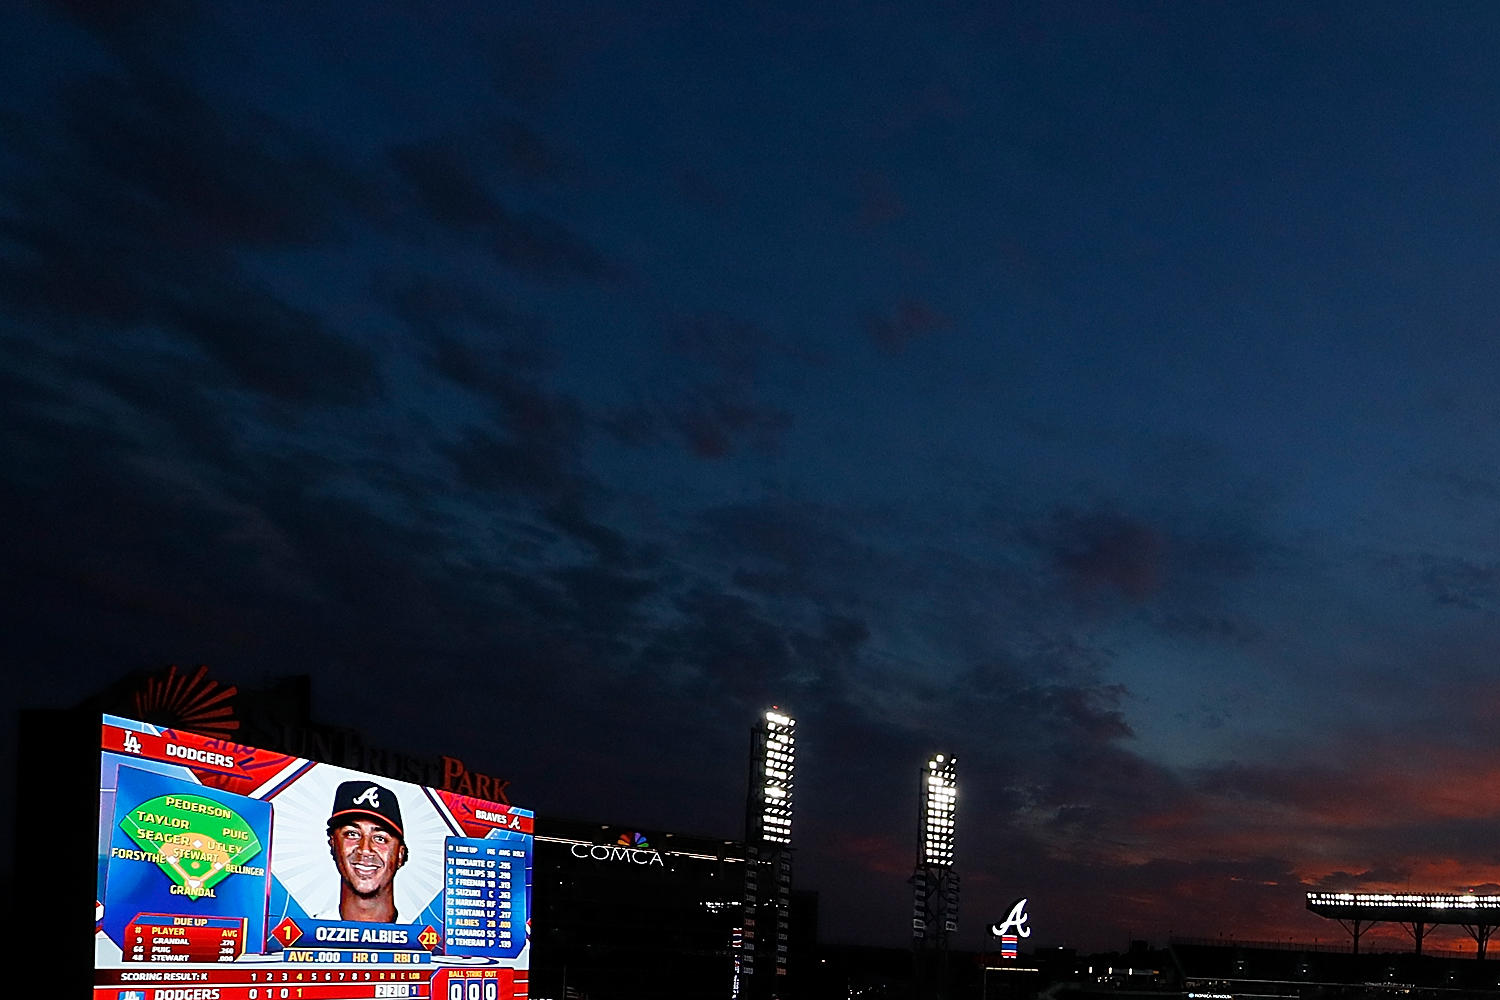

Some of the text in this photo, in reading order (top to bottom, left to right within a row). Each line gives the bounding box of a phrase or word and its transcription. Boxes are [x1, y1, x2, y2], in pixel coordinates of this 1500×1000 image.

[166, 743, 234, 768] DODGERS
[441, 756, 511, 804] PARK
[166, 796, 231, 819] PEDERSON
[137, 810, 190, 829] TAYLOR
[475, 810, 507, 824] BRAVES
[137, 828, 190, 845] SEAGER
[222, 828, 249, 840] PUIG
[207, 841, 242, 854] UTLEY
[112, 848, 166, 864] FORSYTHE
[173, 848, 219, 862] STEWART
[225, 864, 265, 876] BELLINGER
[170, 884, 216, 897] GRANDAL
[455, 908, 486, 917] SANTANA
[486, 910, 496, 918] LF
[173, 917, 208, 927] DUE UP
[455, 918, 480, 927] ALBIES
[152, 926, 185, 936] PLAYER
[222, 930, 238, 938] AVG
[281, 925, 292, 940] 1
[316, 927, 408, 944] OZZIE ALBIES
[422, 931, 438, 945] 2B
[152, 937, 190, 945] GRANDAL
[152, 946, 171, 954] PUIG
[151, 954, 189, 962] STEWART
[288, 951, 420, 963] AVG .000 HR 0 RBI 0
[121, 973, 208, 981] SCORING RESULT: K
[251, 973, 257, 981] 1
[266, 973, 273, 981] 2
[281, 973, 288, 981] 3
[296, 973, 303, 981] 4
[311, 972, 317, 981] 5
[324, 972, 331, 981] 6
[338, 972, 345, 981] 7
[351, 972, 358, 981] 8
[364, 972, 371, 980] 9
[154, 985, 418, 1000] DODGERS 0 1 0 1 2 2 0 1
[486, 983, 497, 1000] 0
